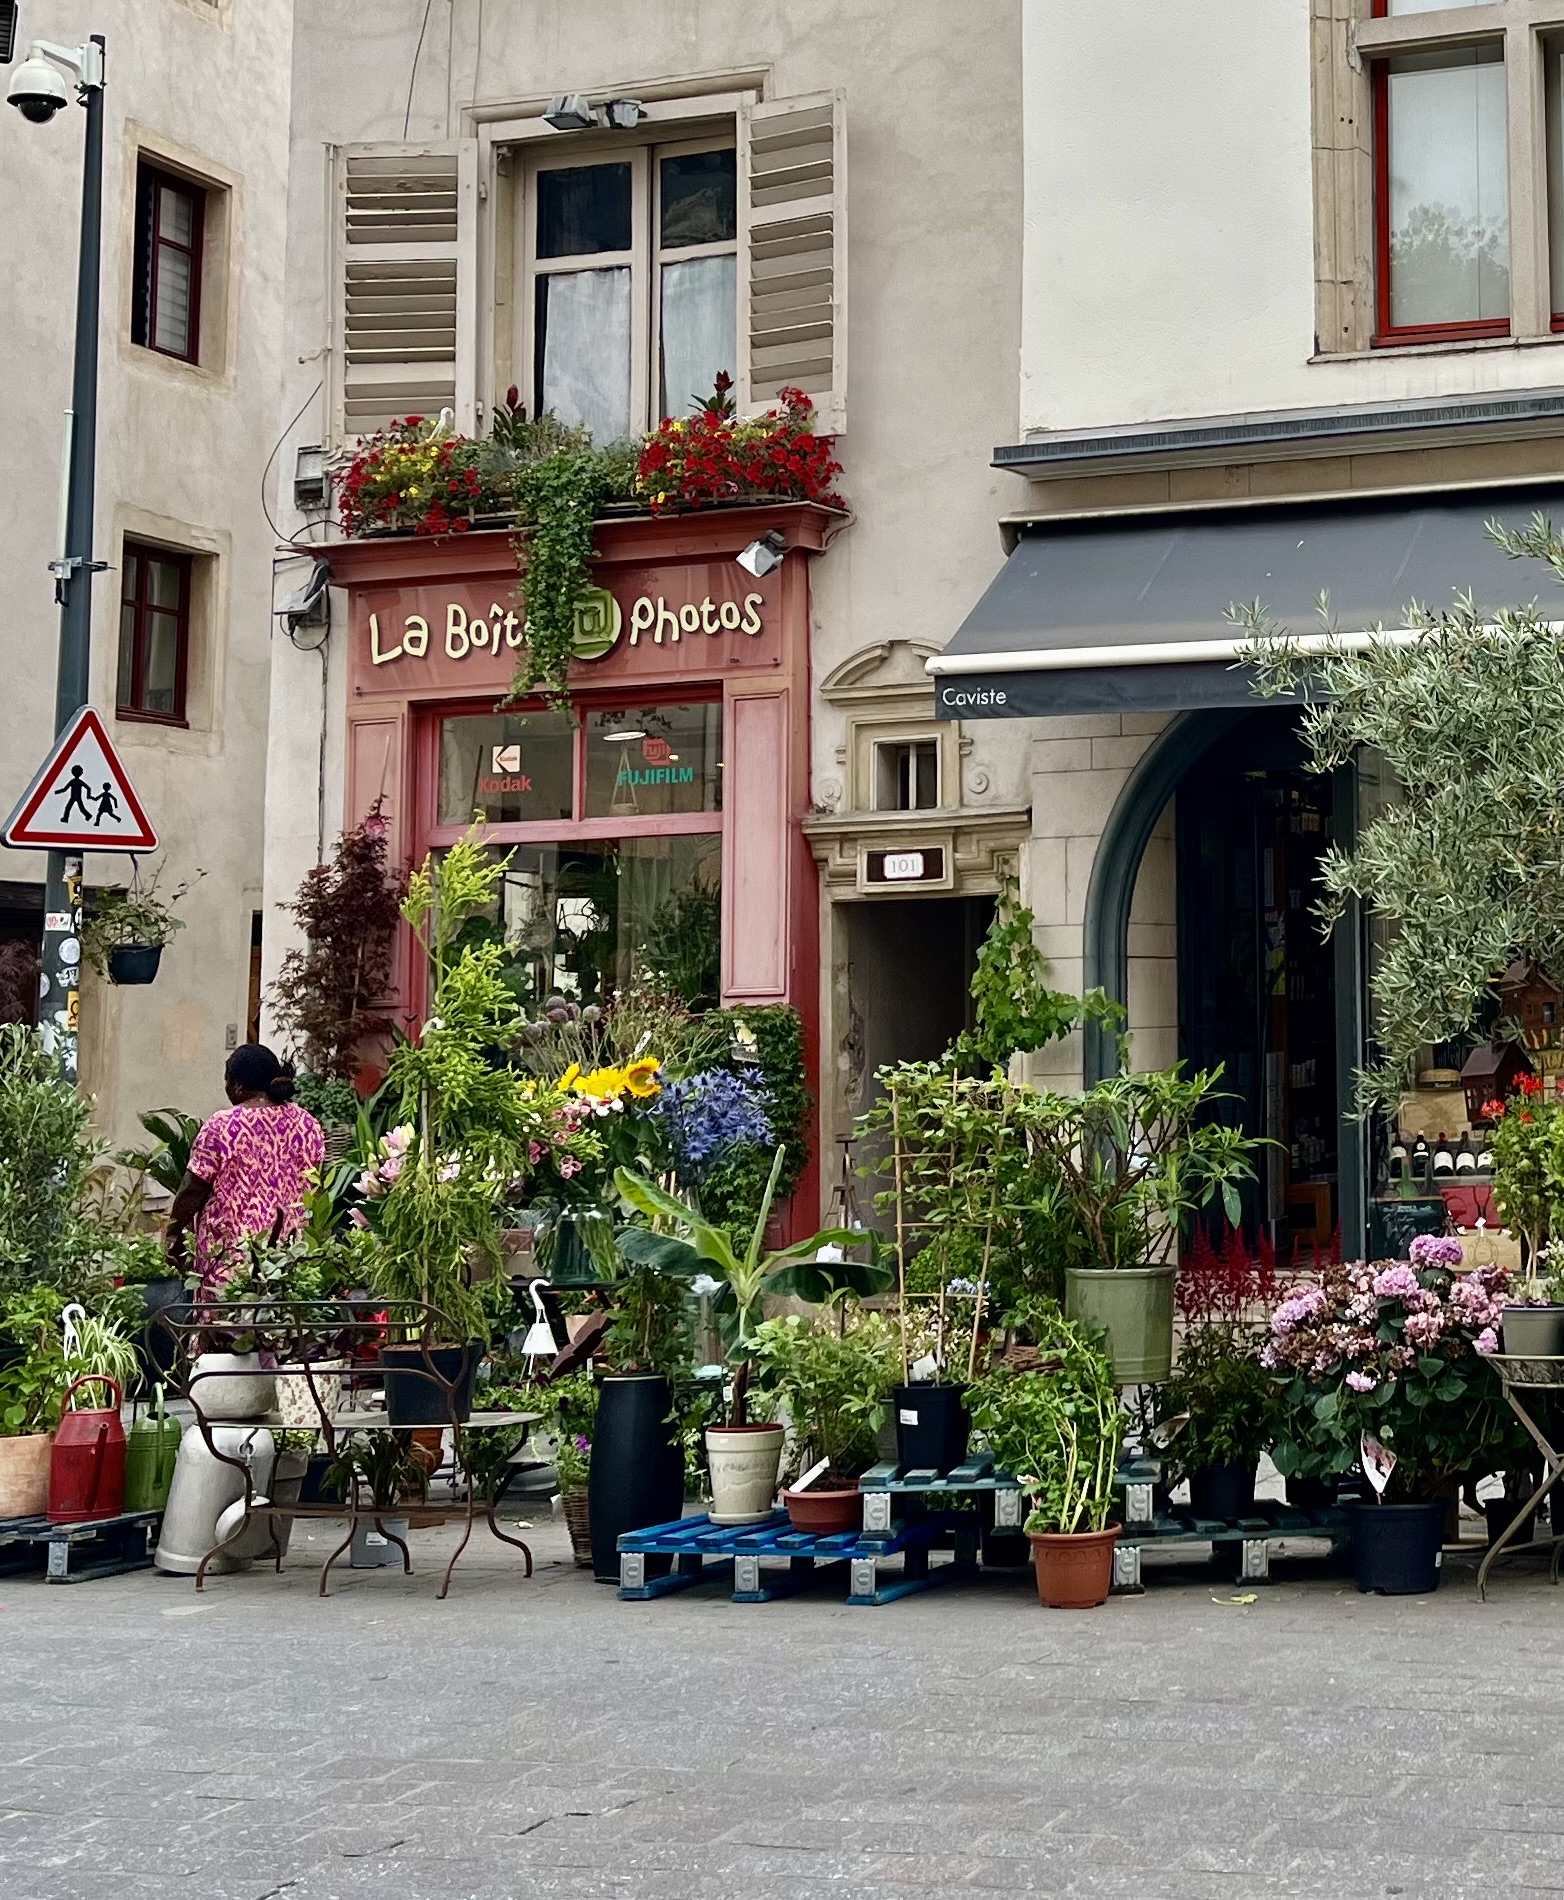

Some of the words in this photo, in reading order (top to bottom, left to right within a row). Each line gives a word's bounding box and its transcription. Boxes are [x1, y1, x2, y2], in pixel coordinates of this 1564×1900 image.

[369, 613, 429, 665] La
[445, 602, 530, 659] Boît
[942, 687, 1007, 706] Caviste
[478, 775, 533, 794] Kodak
[618, 767, 693, 786] FUJIFILM
[891, 859, 917, 873] 101
